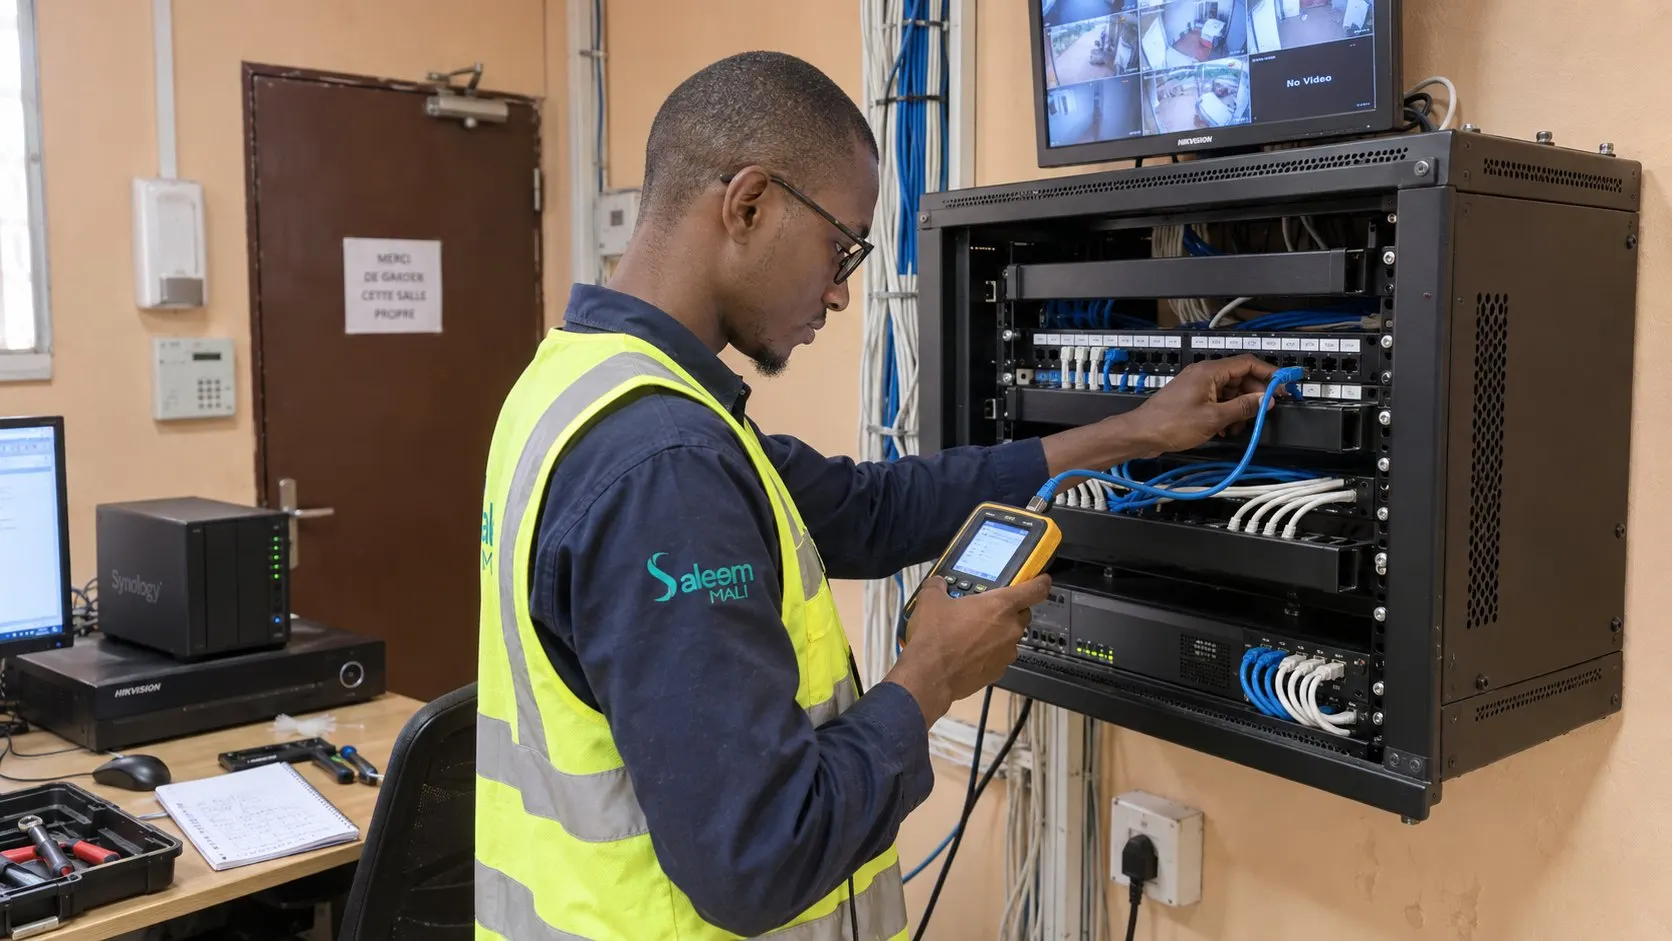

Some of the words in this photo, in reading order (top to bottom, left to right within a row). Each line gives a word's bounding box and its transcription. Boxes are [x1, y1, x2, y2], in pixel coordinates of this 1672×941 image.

[1286, 78, 1301, 88] No
[1303, 74, 1332, 86] Video
[377, 253, 412, 265] MERCI
[364, 271, 378, 283] DE
[361, 290, 393, 301] CETTE
[396, 290, 427, 301] SALLE
[374, 308, 415, 320] PROPRE
[647, 552, 754, 602] Saleem
[111, 568, 161, 603] Synology
[710, 584, 749, 604] MALI
[114, 683, 162, 698] HIKVISION
